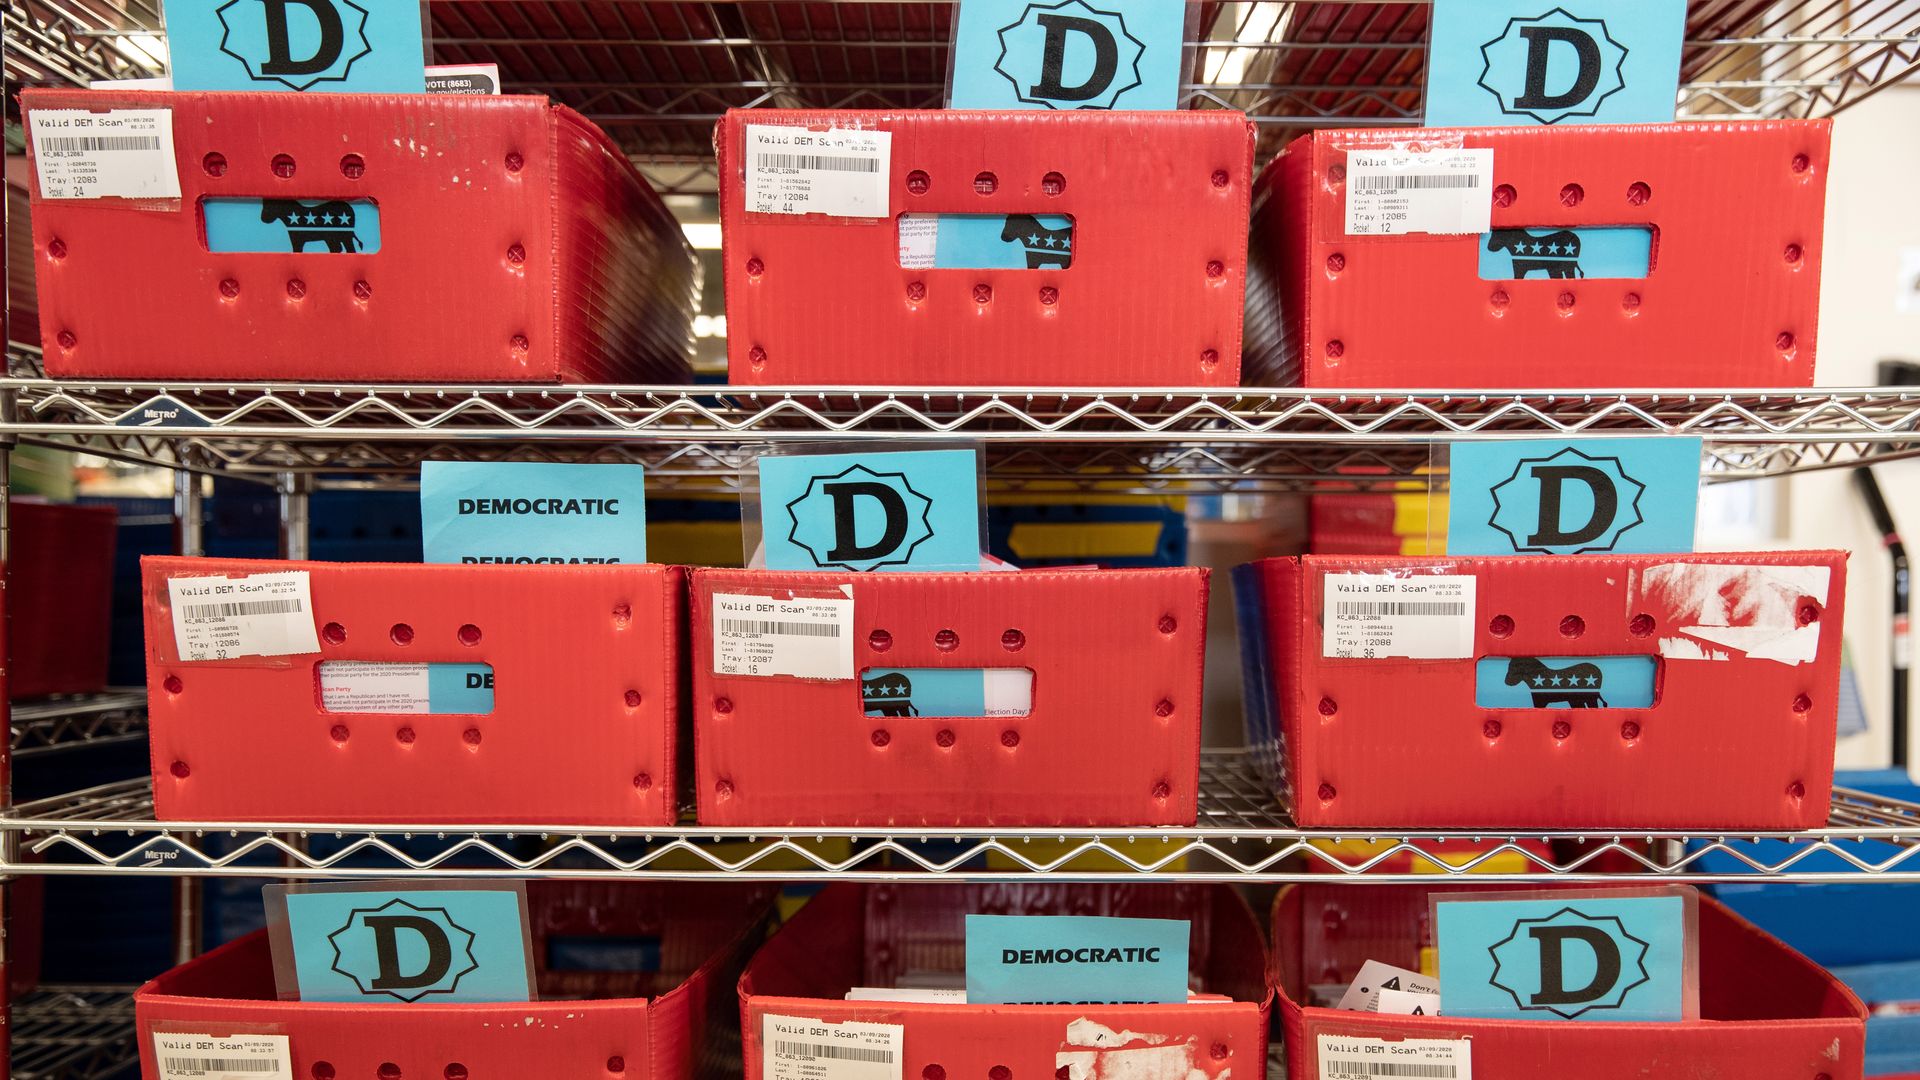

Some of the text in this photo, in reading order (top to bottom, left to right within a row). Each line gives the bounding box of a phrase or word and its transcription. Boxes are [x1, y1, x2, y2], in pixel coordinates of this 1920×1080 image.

[262, 0, 344, 75] D
[1030, 13, 1119, 102] D
[1514, 26, 1601, 110] D
[448, 80, 472, 88] (8683)
[758, 135, 788, 144] Valid
[794, 137, 812, 146] DEM
[74, 187, 84, 197] 24
[783, 203, 793, 212] 44
[1381, 223, 1390, 232] 12
[144, 409, 177, 418] METRO
[458, 498, 620, 515] DEMOCRATIC
[1527, 465, 1618, 546] D
[823, 482, 908, 562] D
[1338, 584, 1370, 593] Valid
[722, 602, 750, 611] Valid
[781, 605, 804, 614] Scan
[216, 650, 227, 659] 32
[1364, 649, 1374, 658] 36
[748, 665, 758, 674] 16
[466, 673, 494, 689] DE
[145, 850, 177, 859] METRO
[364, 916, 452, 989] D
[1002, 948, 1160, 964] DEMOCRATIC
[1530, 926, 1621, 1005] D
[1410, 982, 1430, 992] Don't
[775, 1024, 858, 1038] Valid DEM Scan
[1327, 1044, 1358, 1053] Valid
[1365, 1046, 1384, 1054] DEM
